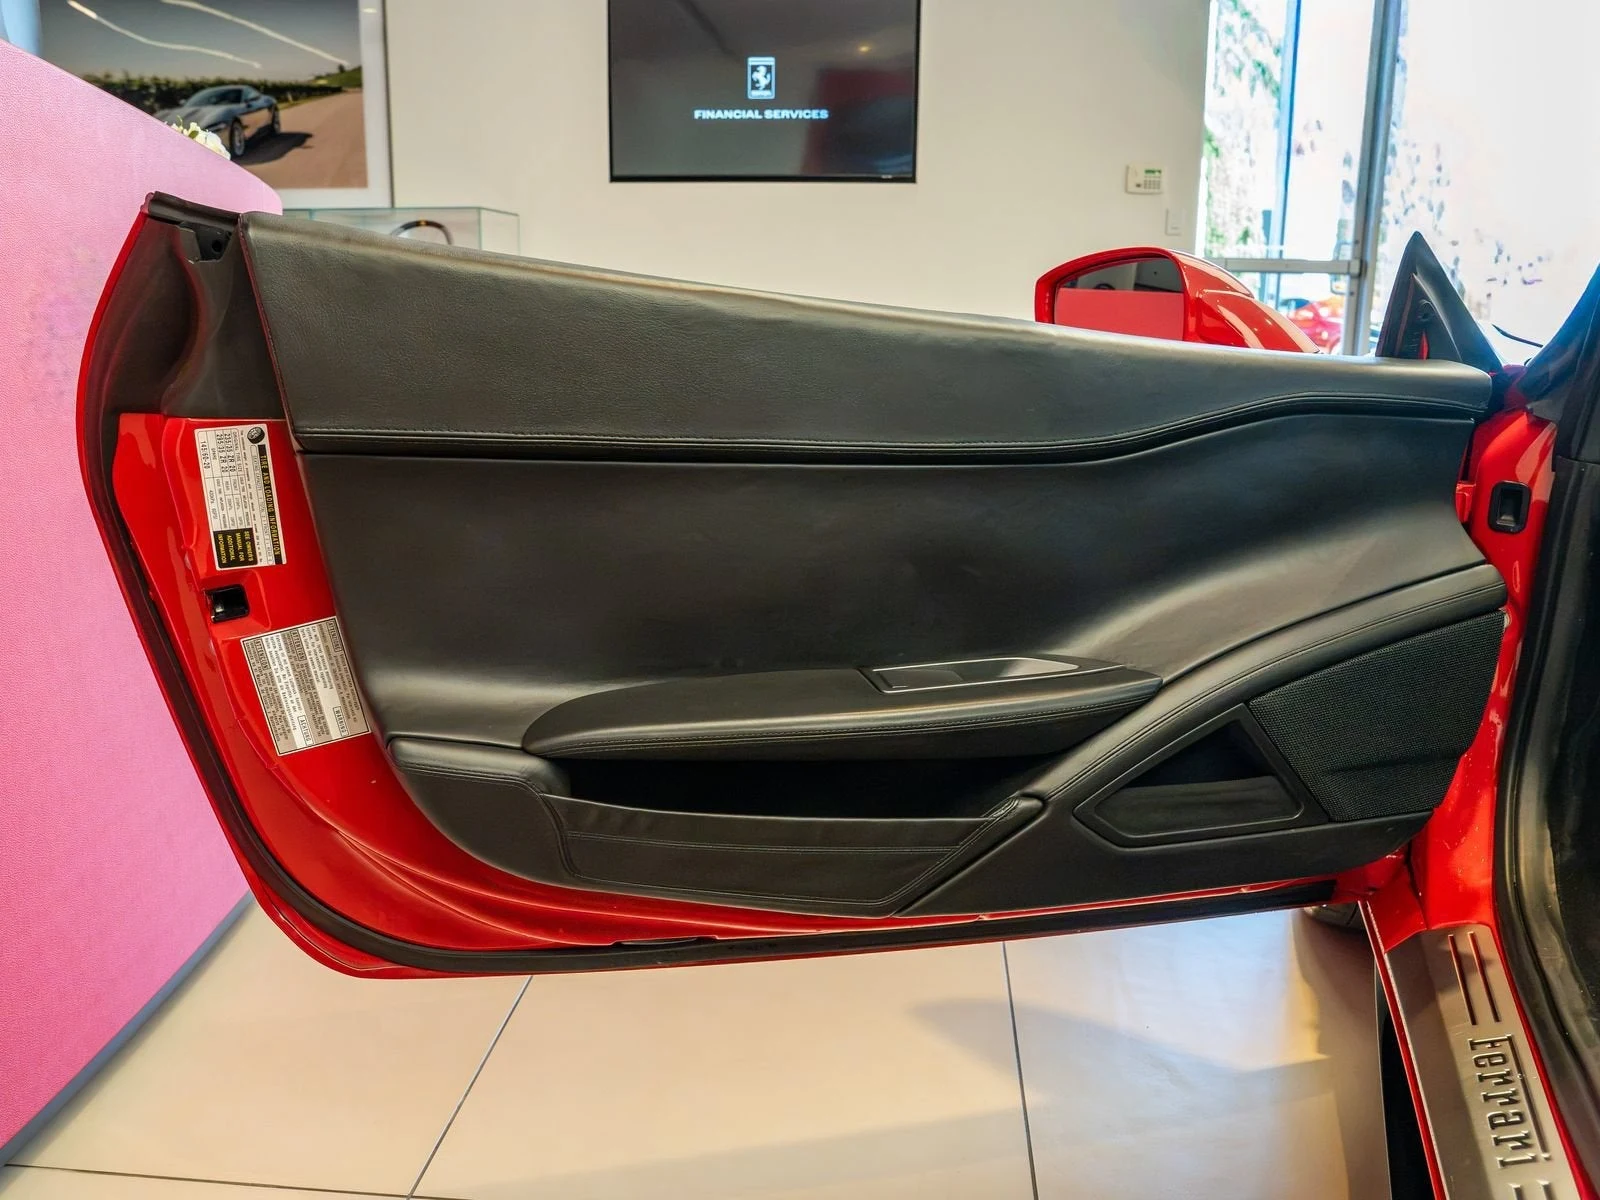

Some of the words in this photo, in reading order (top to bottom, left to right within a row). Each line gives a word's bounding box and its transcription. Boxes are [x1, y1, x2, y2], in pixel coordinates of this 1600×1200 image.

[693, 109, 763, 119] FINANCIAL
[764, 109, 829, 119] SERVICES
[259, 455, 268, 468] TIRE
[262, 471, 270, 484] AND
[264, 484, 274, 512] LOADING
[234, 532, 243, 550] MANUAL
[268, 515, 280, 555] INFORMATION
[216, 533, 227, 563] INFORMATION
[225, 534, 235, 561] ADDITIONAL
[237, 551, 245, 562] FOR
[1468, 1033, 1551, 1169] Ferrari
